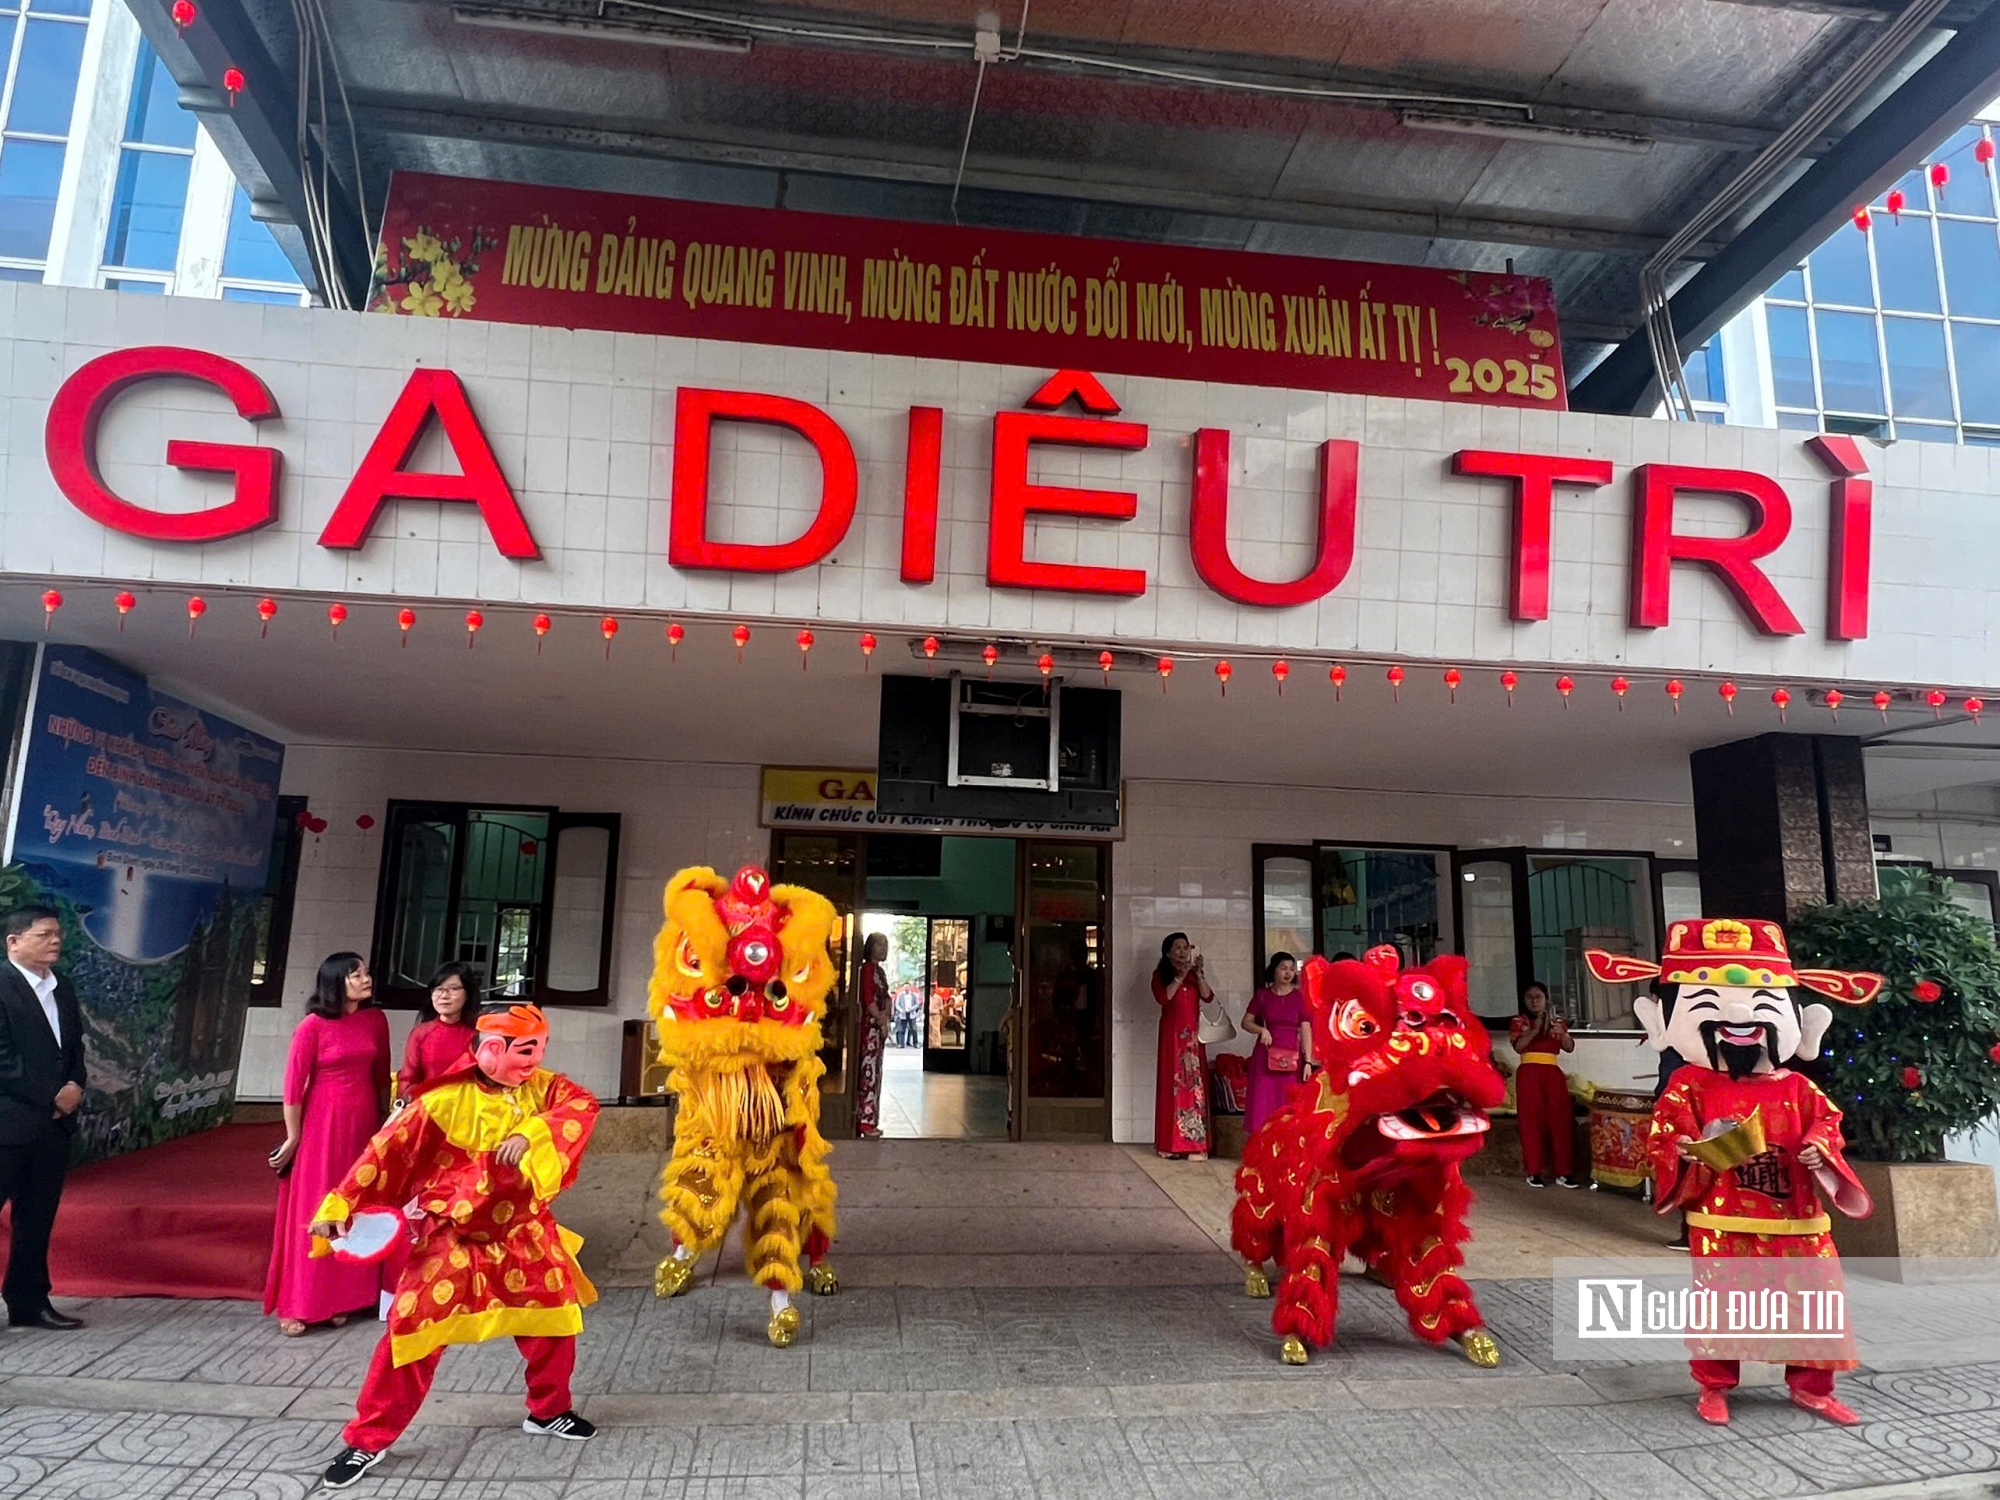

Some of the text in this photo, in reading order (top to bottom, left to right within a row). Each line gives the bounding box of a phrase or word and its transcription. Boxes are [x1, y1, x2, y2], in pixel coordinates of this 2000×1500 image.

[502, 213, 592, 292] MỪNG
[596, 215, 676, 300] ĐẢNG
[682, 242, 775, 309] QUANG
[784, 251, 852, 324] VINH,
[861, 248, 942, 324] MỪNG
[949, 247, 999, 328] ĐẤT
[1007, 262, 1078, 335] NƯỚC
[1085, 256, 1128, 340] ĐỔI
[1136, 272, 1193, 353] MỚI,
[1200, 276, 1277, 352] MỪNG
[1282, 285, 1352, 358] XUÂN
[1359, 280, 1387, 360] ẤT
[1444, 357, 1558, 400] 2025
[45, 346, 1873, 642] GA DIÊU TRÌ
[818, 779, 876, 801] GA
[774, 804, 816, 821] KÍNH
[819, 805, 863, 823] CHÚC
